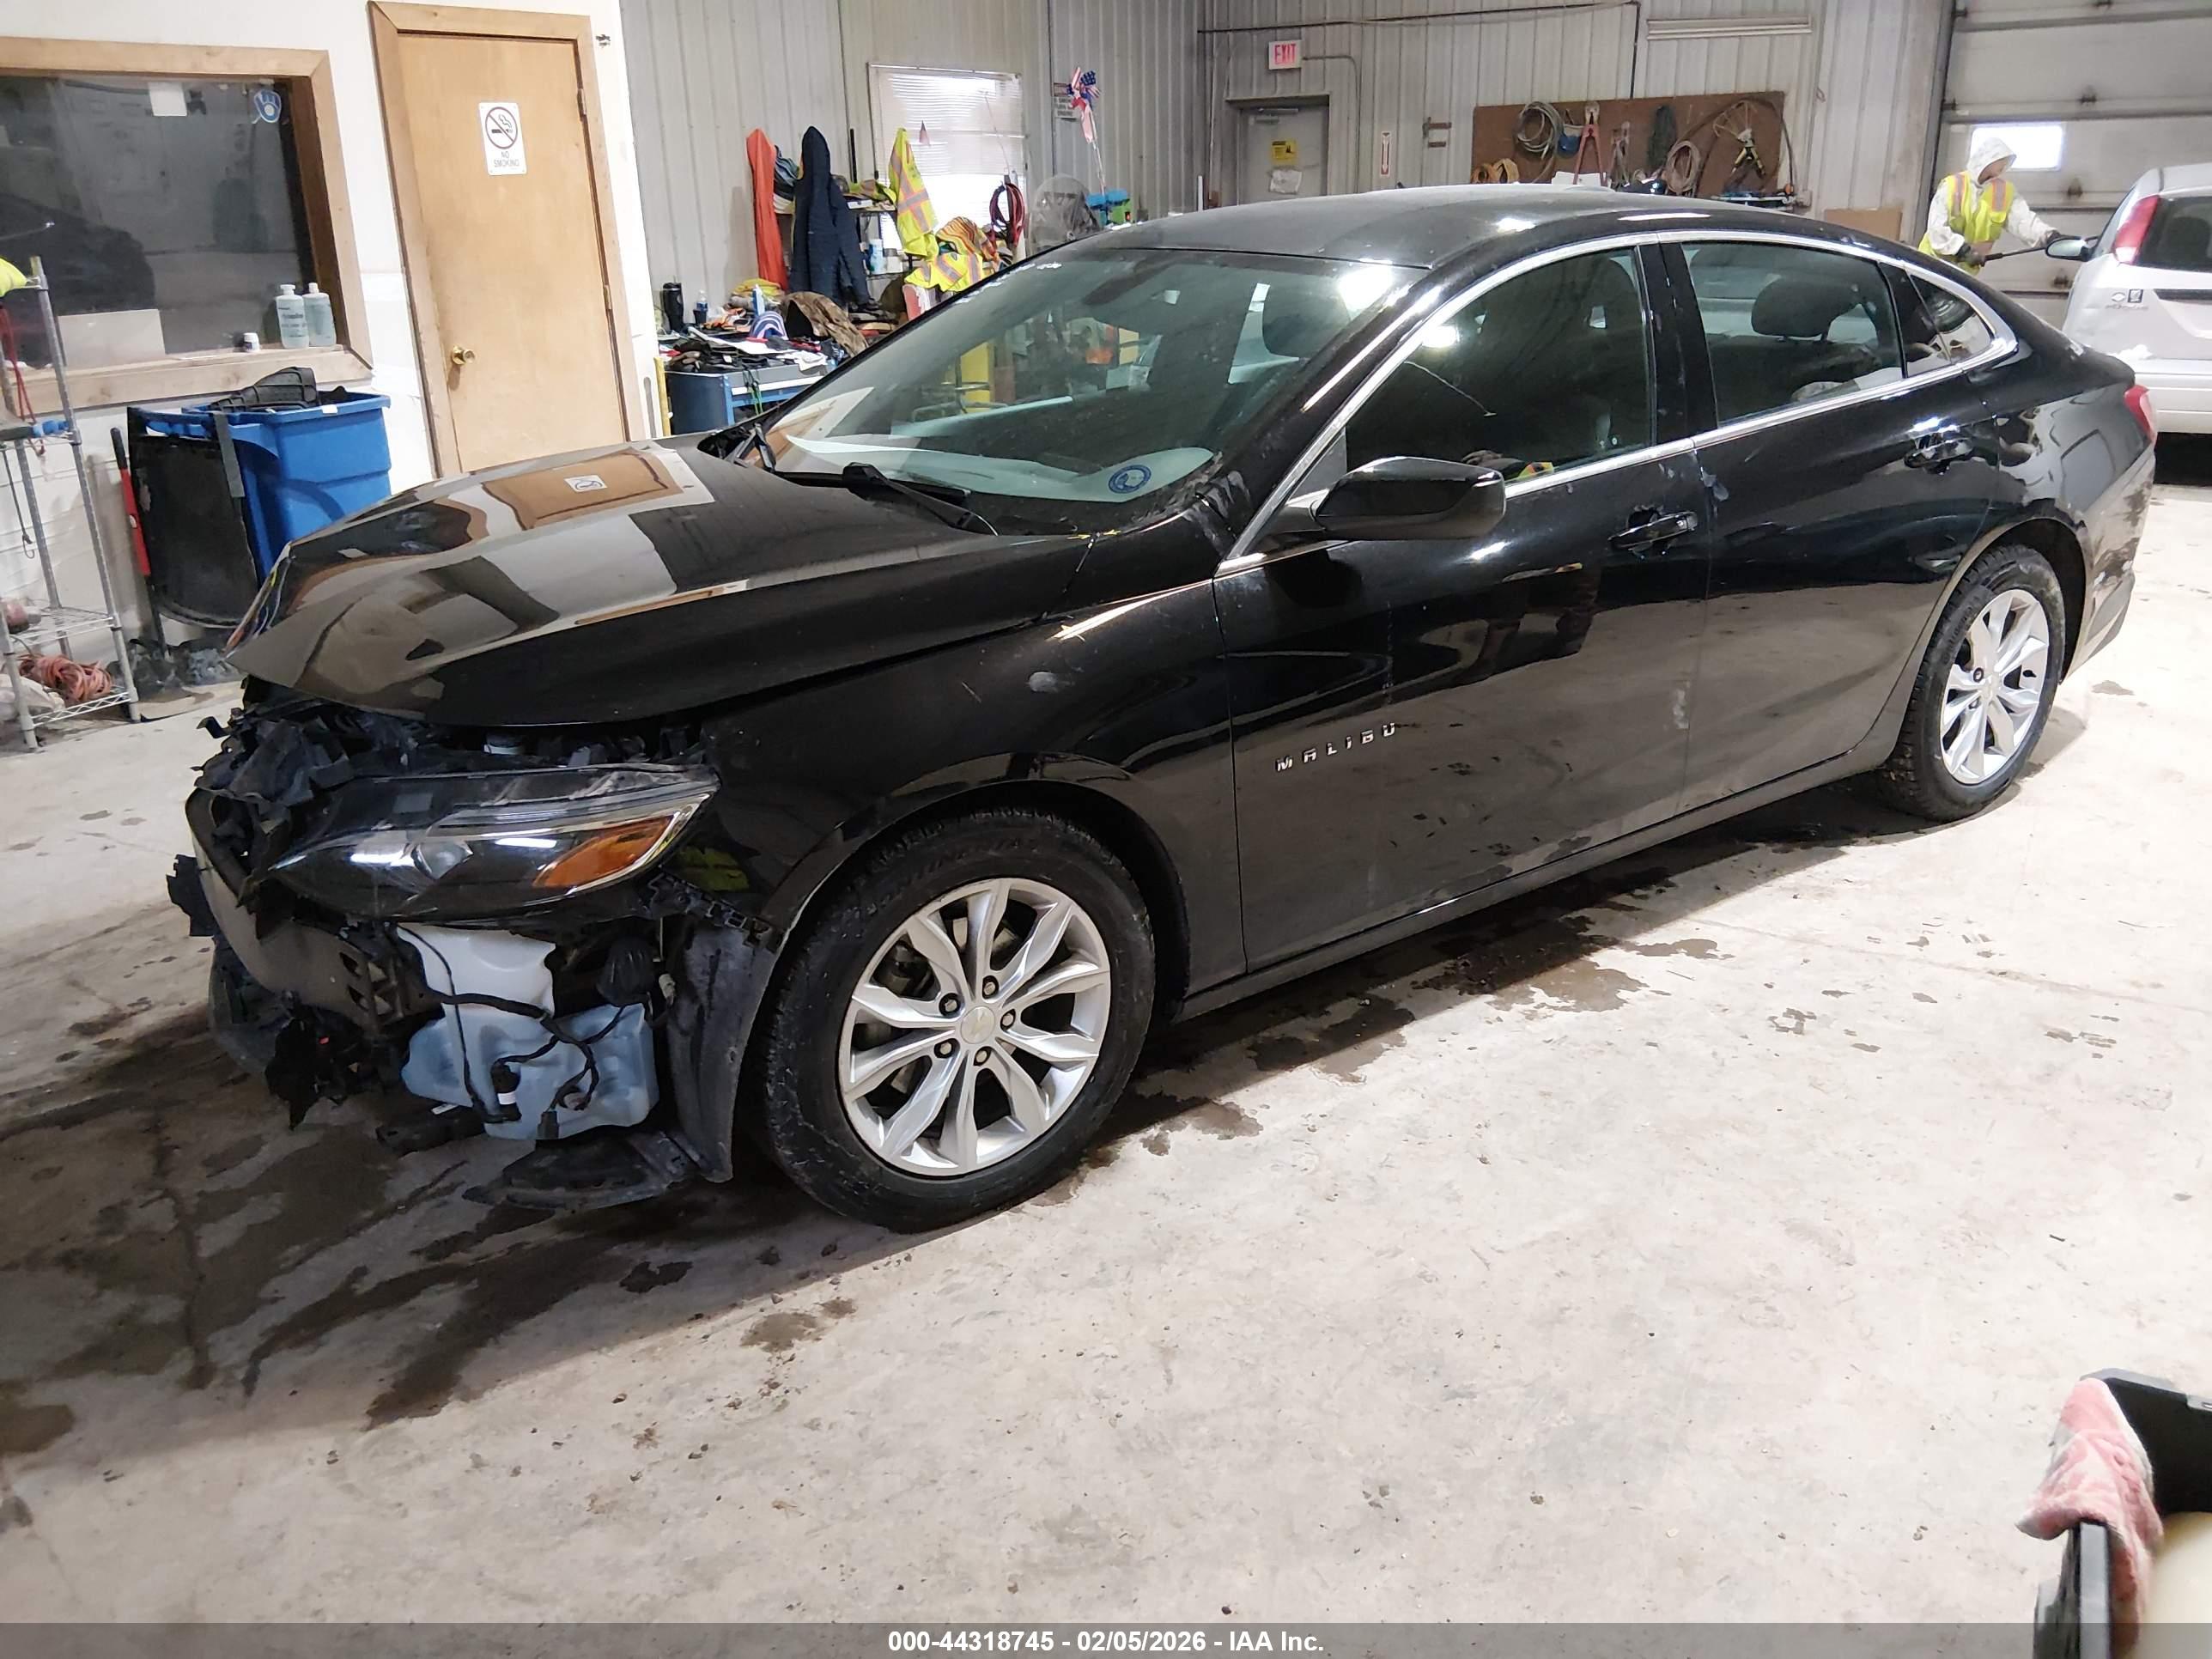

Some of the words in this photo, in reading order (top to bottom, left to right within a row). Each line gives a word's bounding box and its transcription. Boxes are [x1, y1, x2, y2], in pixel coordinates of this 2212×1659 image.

[1274, 44, 1296, 64] EXIT
[494, 159, 520, 167] SMOKING
[1276, 723, 1395, 772] MALIBU
